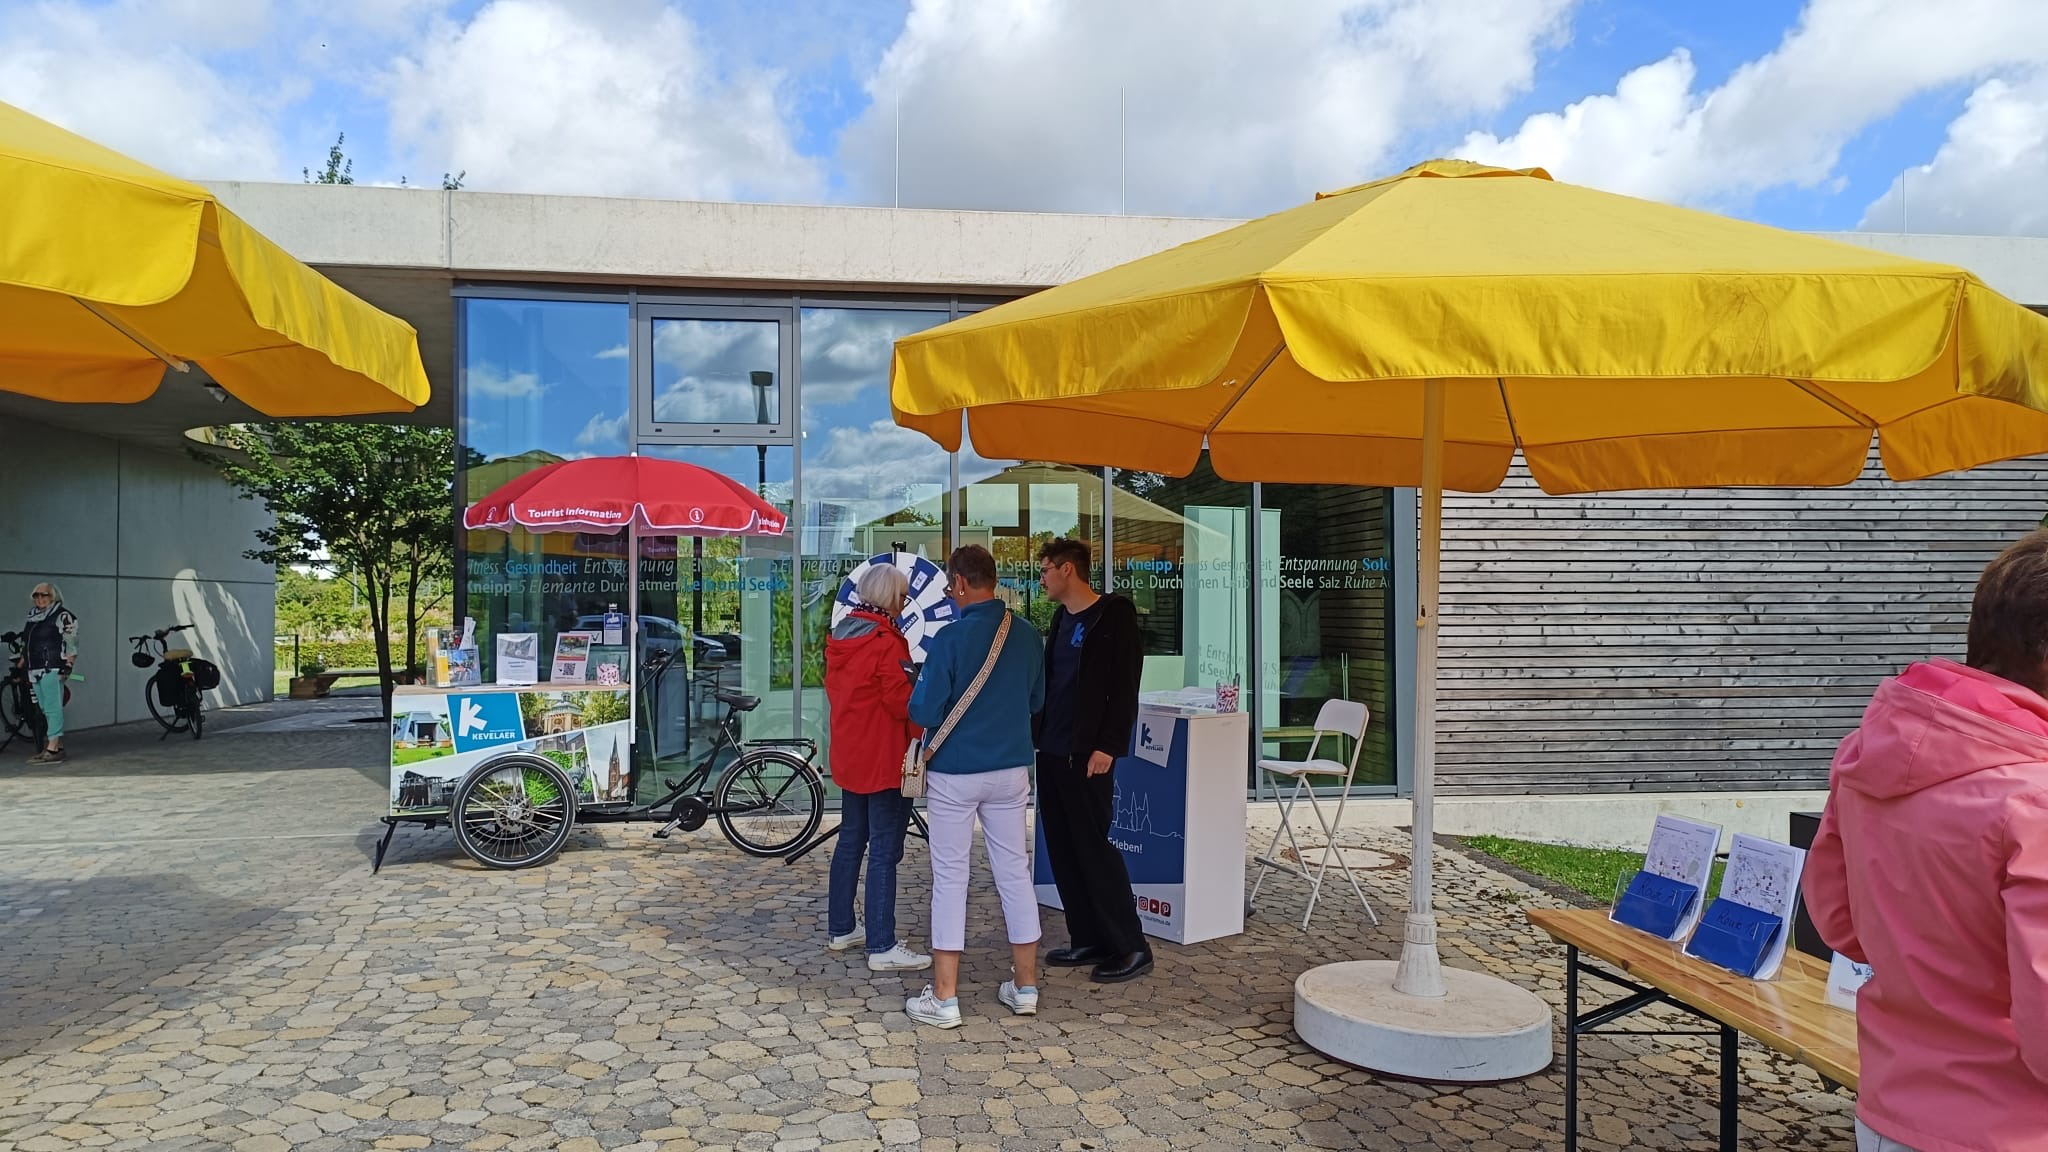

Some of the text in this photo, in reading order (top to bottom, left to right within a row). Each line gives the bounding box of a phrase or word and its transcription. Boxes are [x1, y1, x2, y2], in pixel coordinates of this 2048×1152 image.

[528, 507, 621, 519] Tourist Information
[505, 560, 577, 575] Gesundheit
[1127, 556, 1173, 574] Kneipp
[1279, 556, 1357, 573] Entspannung
[519, 579, 527, 593] 5
[529, 579, 595, 593] Elemente
[1112, 575, 1144, 590] Sole
[1280, 575, 1314, 589] Seele
[1318, 575, 1341, 589] Salz
[1344, 575, 1376, 589] Ruhe
[472, 731, 516, 741] KEVELAER
